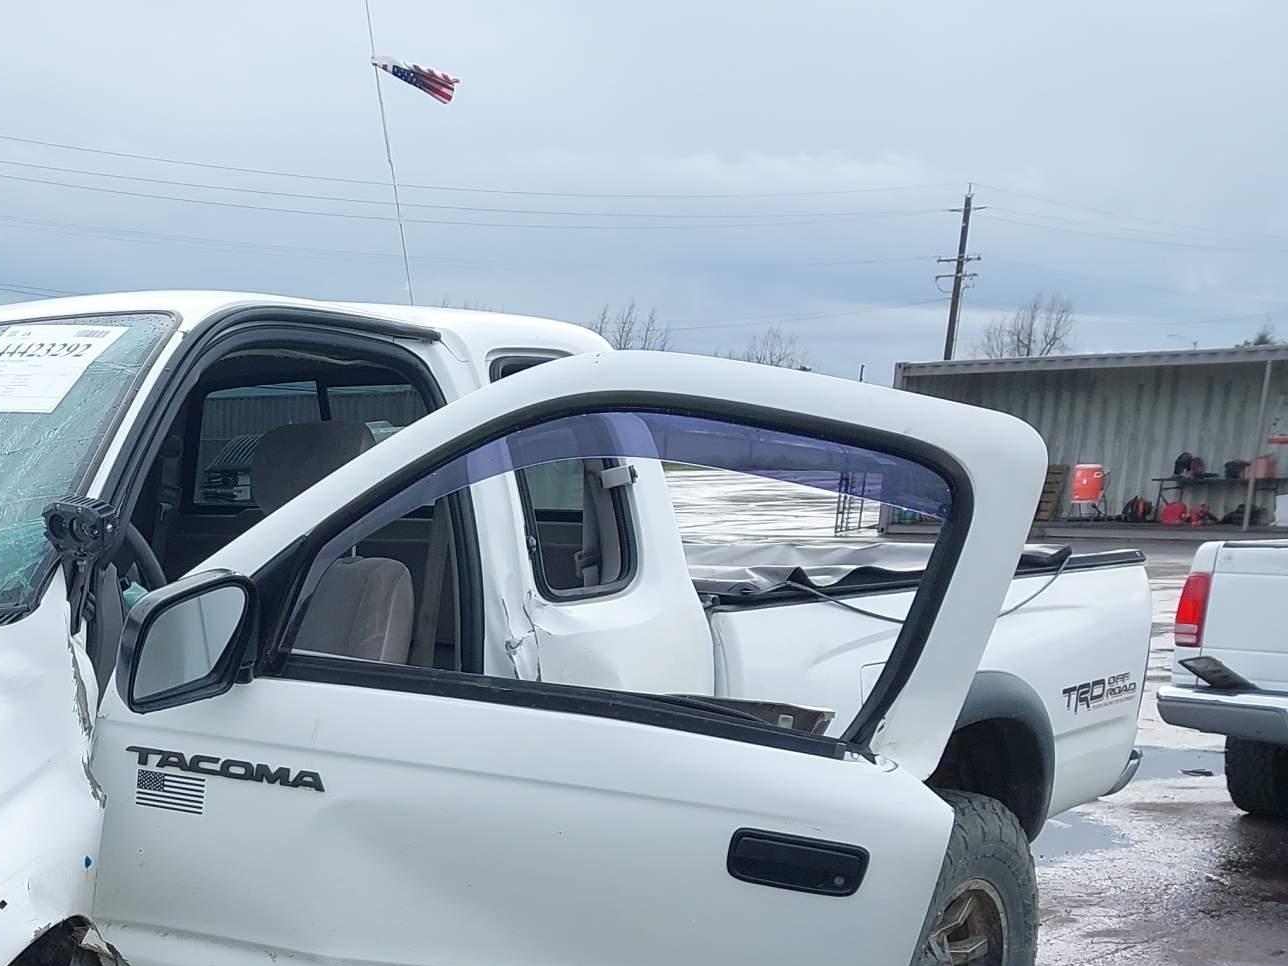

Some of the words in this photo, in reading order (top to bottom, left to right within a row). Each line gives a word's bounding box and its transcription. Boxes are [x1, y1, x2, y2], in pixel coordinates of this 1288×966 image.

[1062, 678, 1106, 715] TRD
[1108, 672, 1130, 686] OFF
[1106, 682, 1137, 698] ROAD
[125, 745, 326, 793] TACOMA
